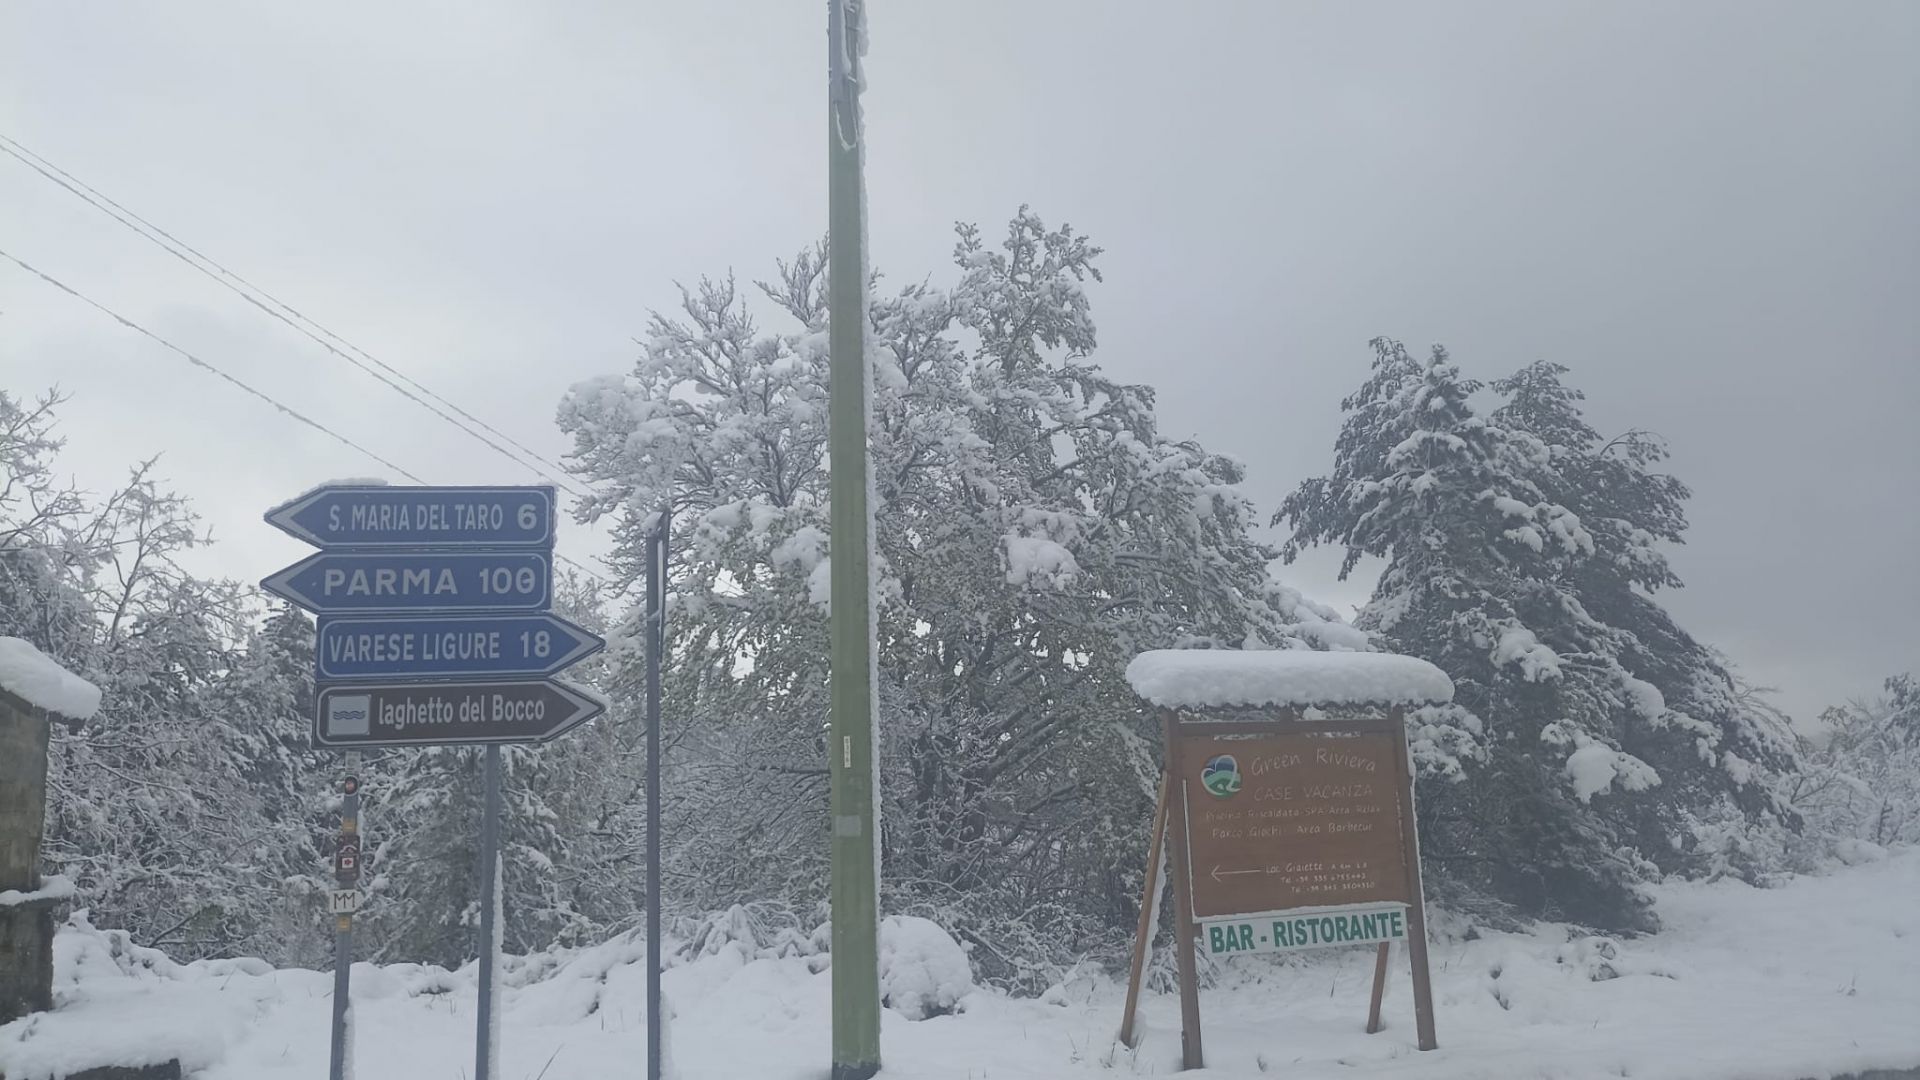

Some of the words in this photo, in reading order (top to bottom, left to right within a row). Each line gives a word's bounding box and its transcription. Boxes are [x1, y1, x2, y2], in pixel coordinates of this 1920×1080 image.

[328, 504, 345, 531] S.
[352, 503, 411, 531] MARIA
[416, 504, 449, 531] DEL
[455, 503, 503, 530] TARO
[517, 503, 537, 530] 6
[324, 568, 458, 596] PARMA
[479, 567, 536, 594] 100
[329, 633, 414, 662] VARESE
[422, 632, 500, 660] LIGURE
[520, 630, 551, 658] 18
[378, 698, 454, 730] laghetto
[459, 696, 486, 723] del
[492, 694, 545, 722] Bocco
[1251, 753, 1302, 777] Green
[1316, 747, 1376, 773] Riviera
[1253, 785, 1293, 802] CASE
[1303, 783, 1373, 800] VACANZA
[1209, 923, 1255, 954] BAR
[1260, 934, 1268, 943] -
[1272, 911, 1404, 948] RISTORANTE
